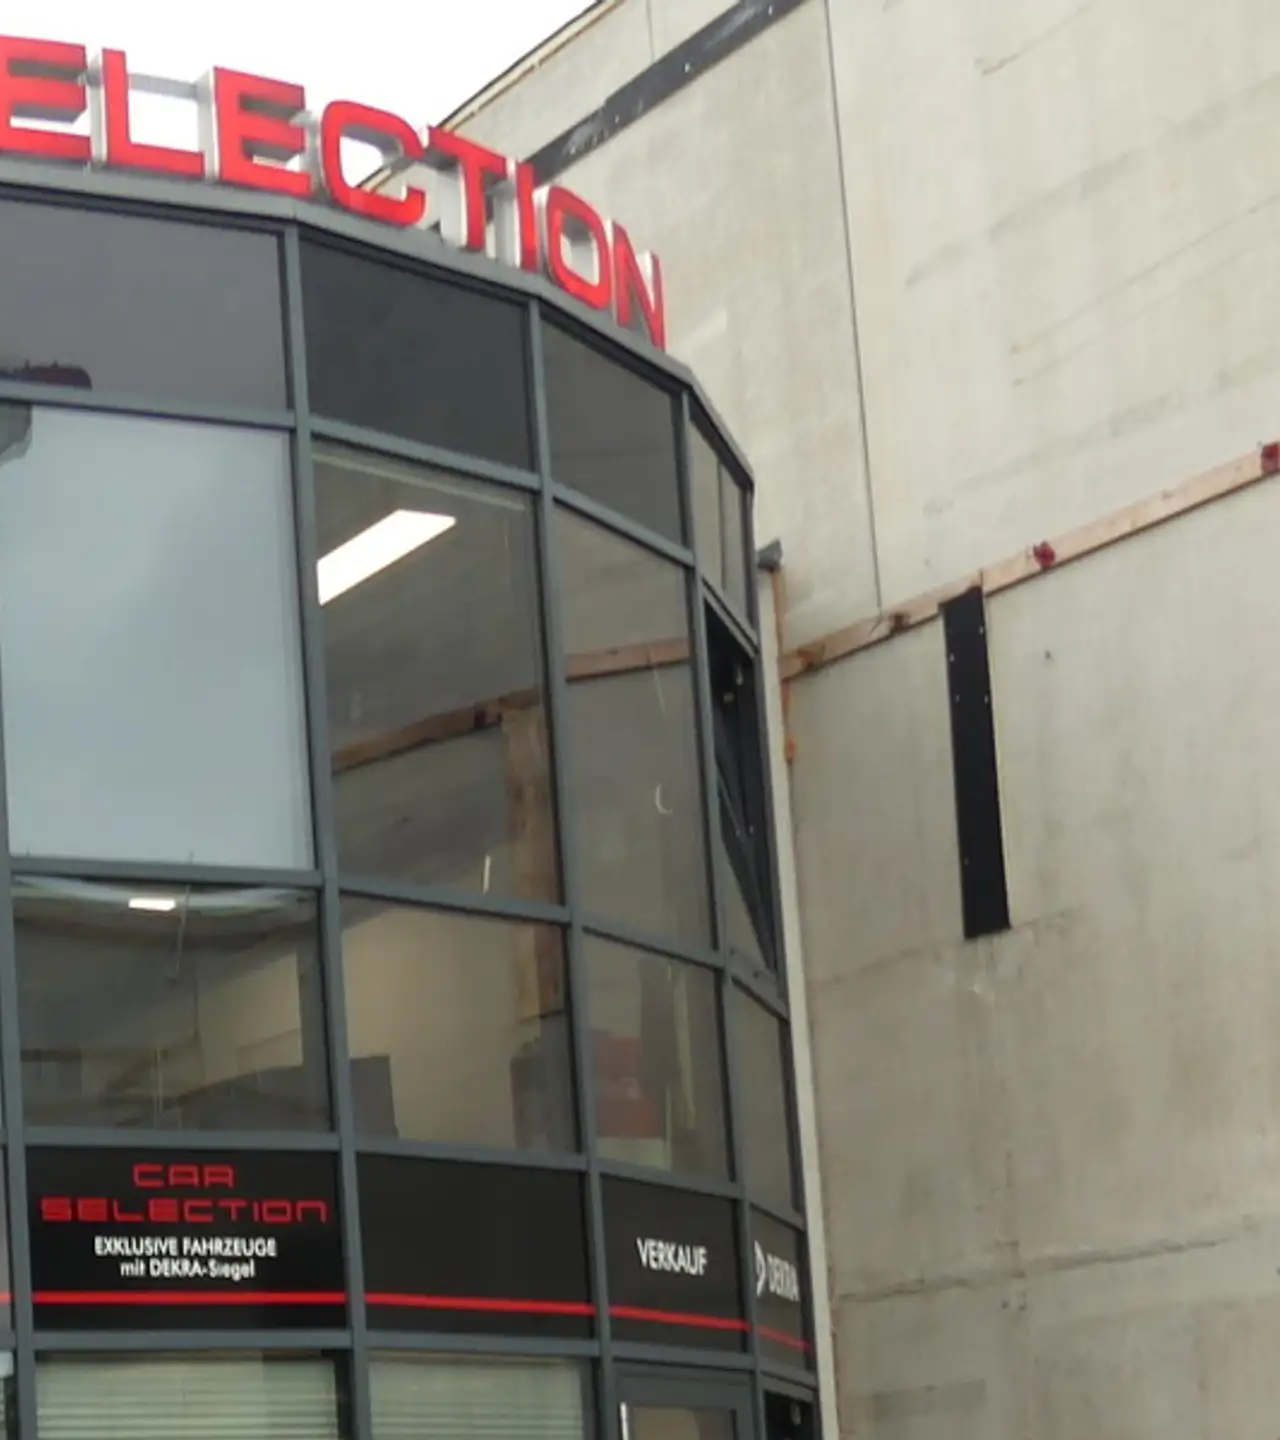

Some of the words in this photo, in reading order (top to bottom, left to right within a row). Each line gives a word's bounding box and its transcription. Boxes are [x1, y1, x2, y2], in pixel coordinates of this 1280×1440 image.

[133, 1163, 235, 1189] CAR
[41, 1196, 328, 1224] SELECTION
[94, 1236, 178, 1257] EXKLUSIVE
[182, 1237, 277, 1257] FAHRZEUGE
[636, 1238, 708, 1276] VERKAUF
[120, 1260, 146, 1277] mit
[149, 1259, 256, 1282] DEKRA-Siegel
